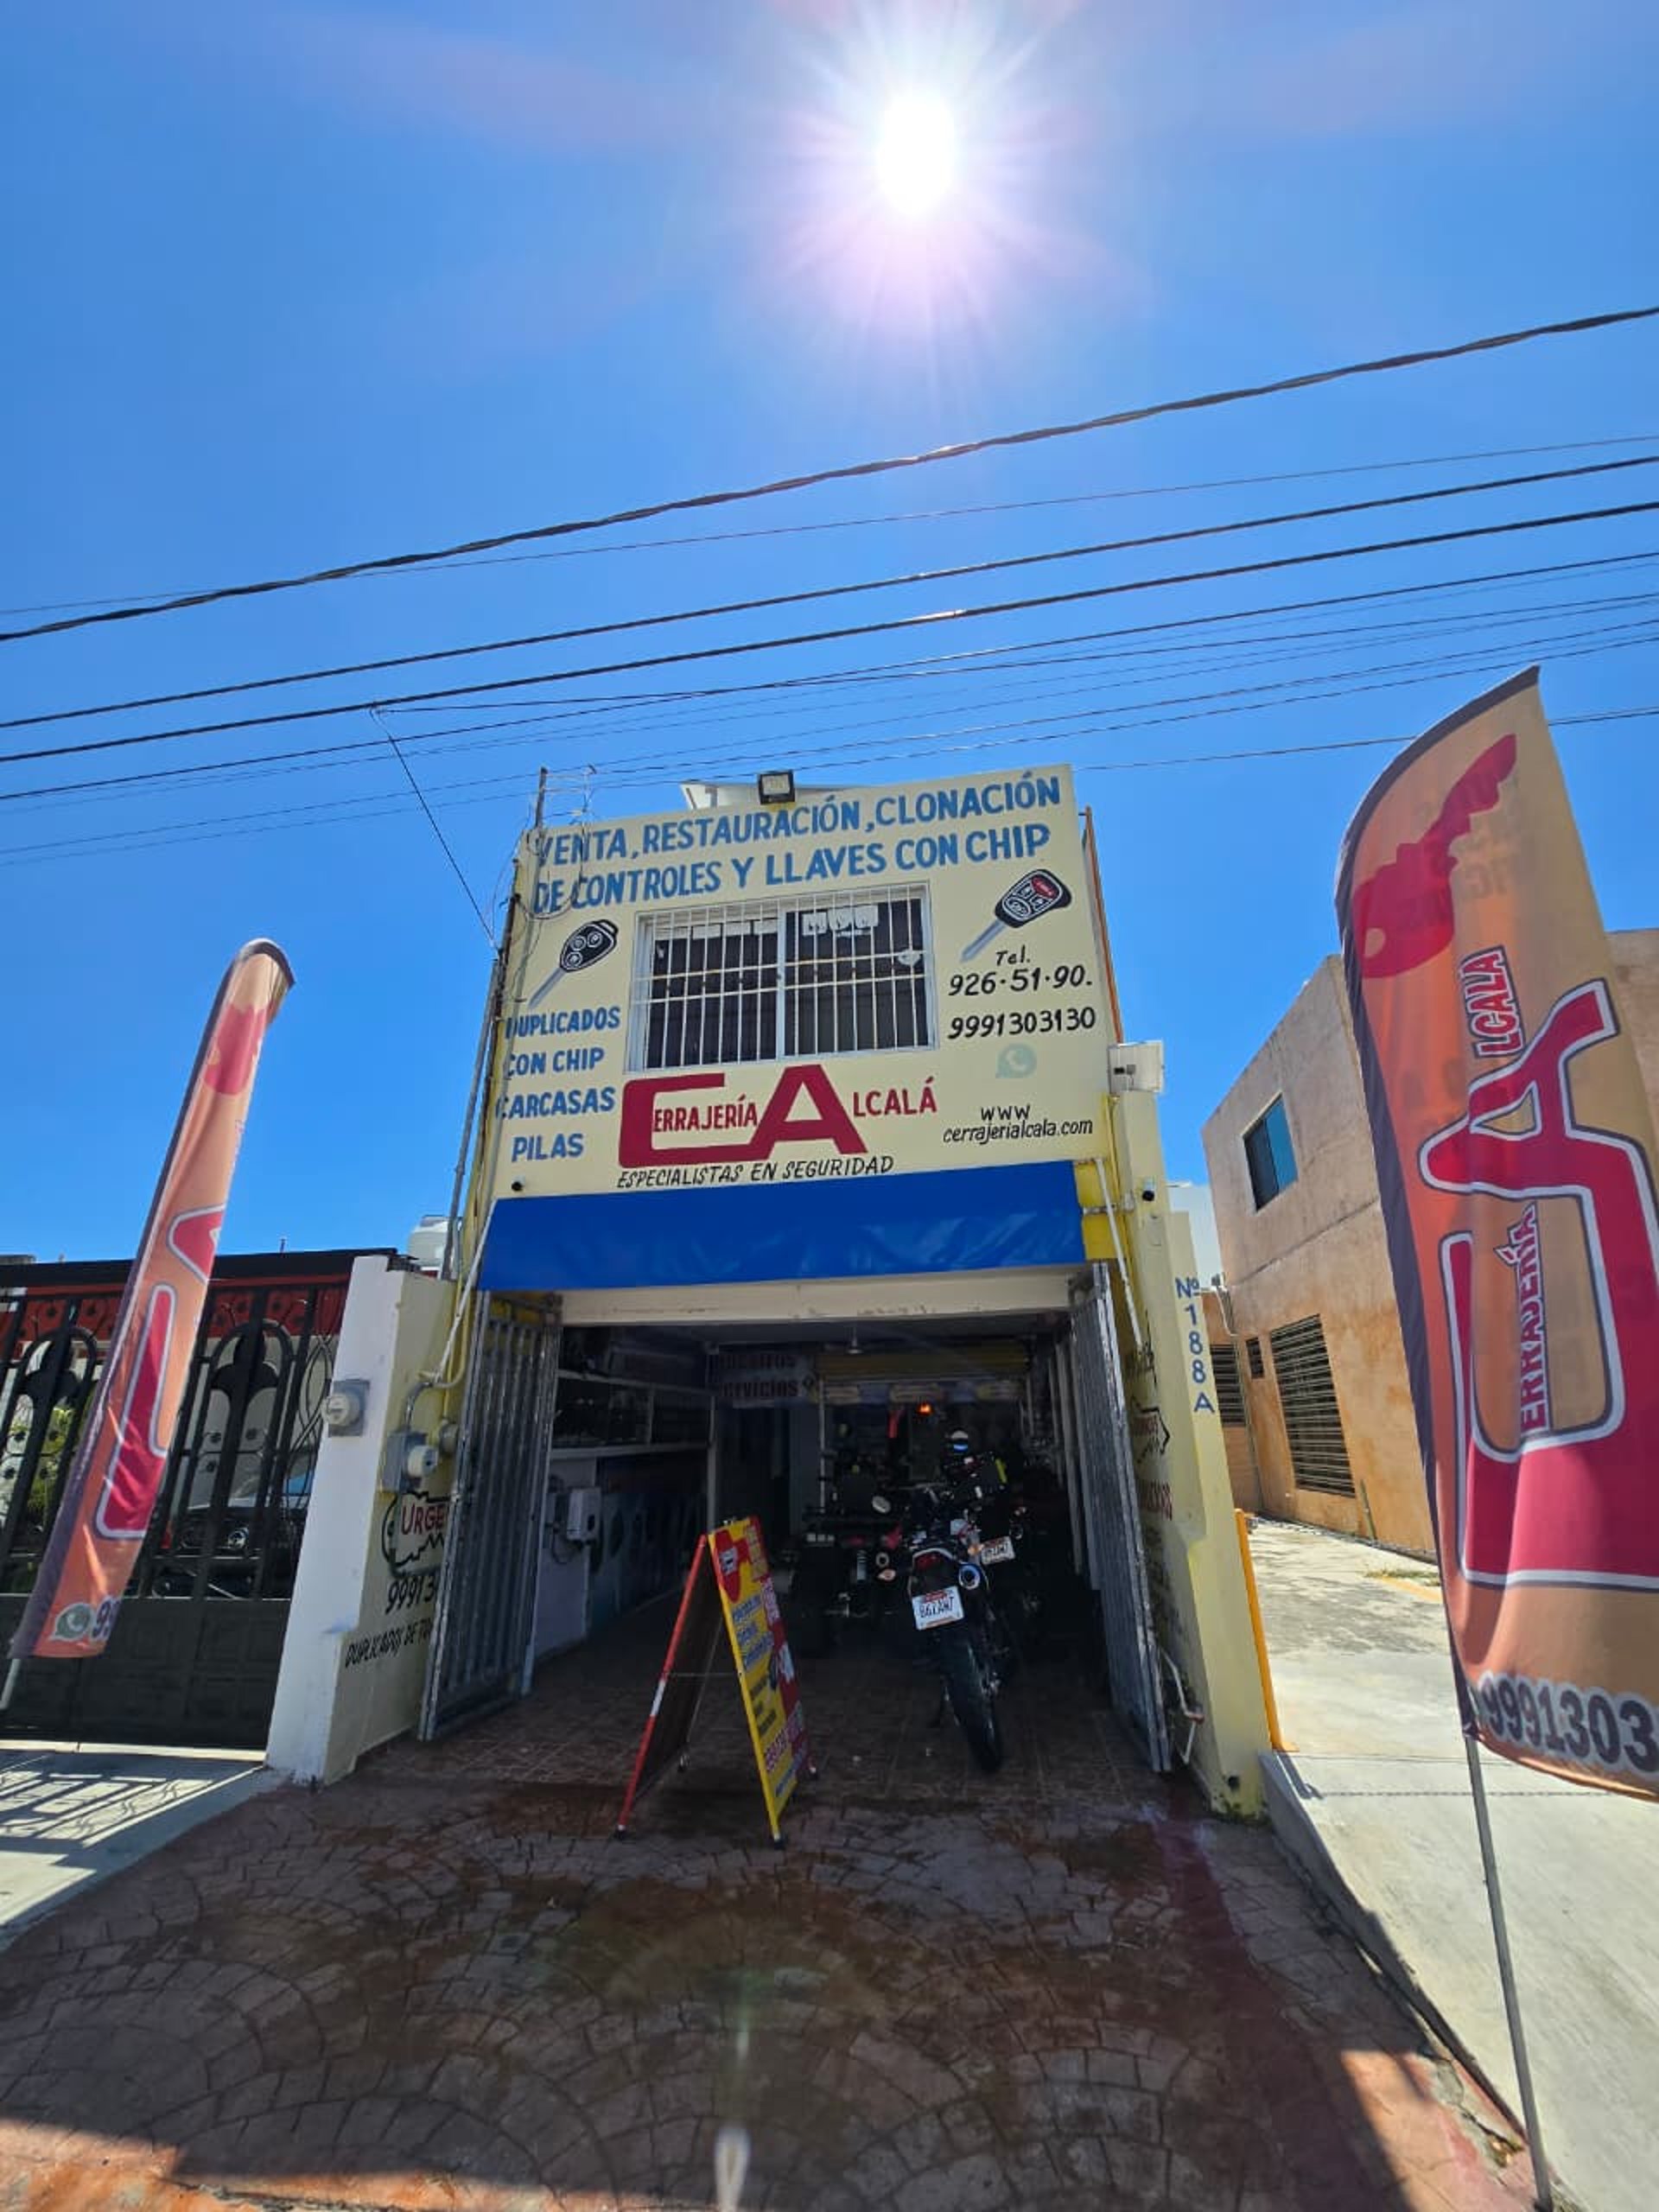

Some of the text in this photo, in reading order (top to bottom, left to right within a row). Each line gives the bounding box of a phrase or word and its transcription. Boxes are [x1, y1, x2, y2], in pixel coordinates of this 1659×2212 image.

[875, 772, 1061, 826] CLONACIÓN
[534, 823, 1052, 914] DE CONTROLES Y LLAVES CON CHIP
[995, 944, 1031, 966] Tel.
[505, 1006, 620, 1039] DUPLICADOS
[947, 1007, 1096, 1039] 9991303130
[553, 1046, 604, 1072] CHIP
[512, 1133, 584, 1162] PILAS
[617, 1155, 894, 1189] ESPECIALISTAS EN SEGURIDAD
